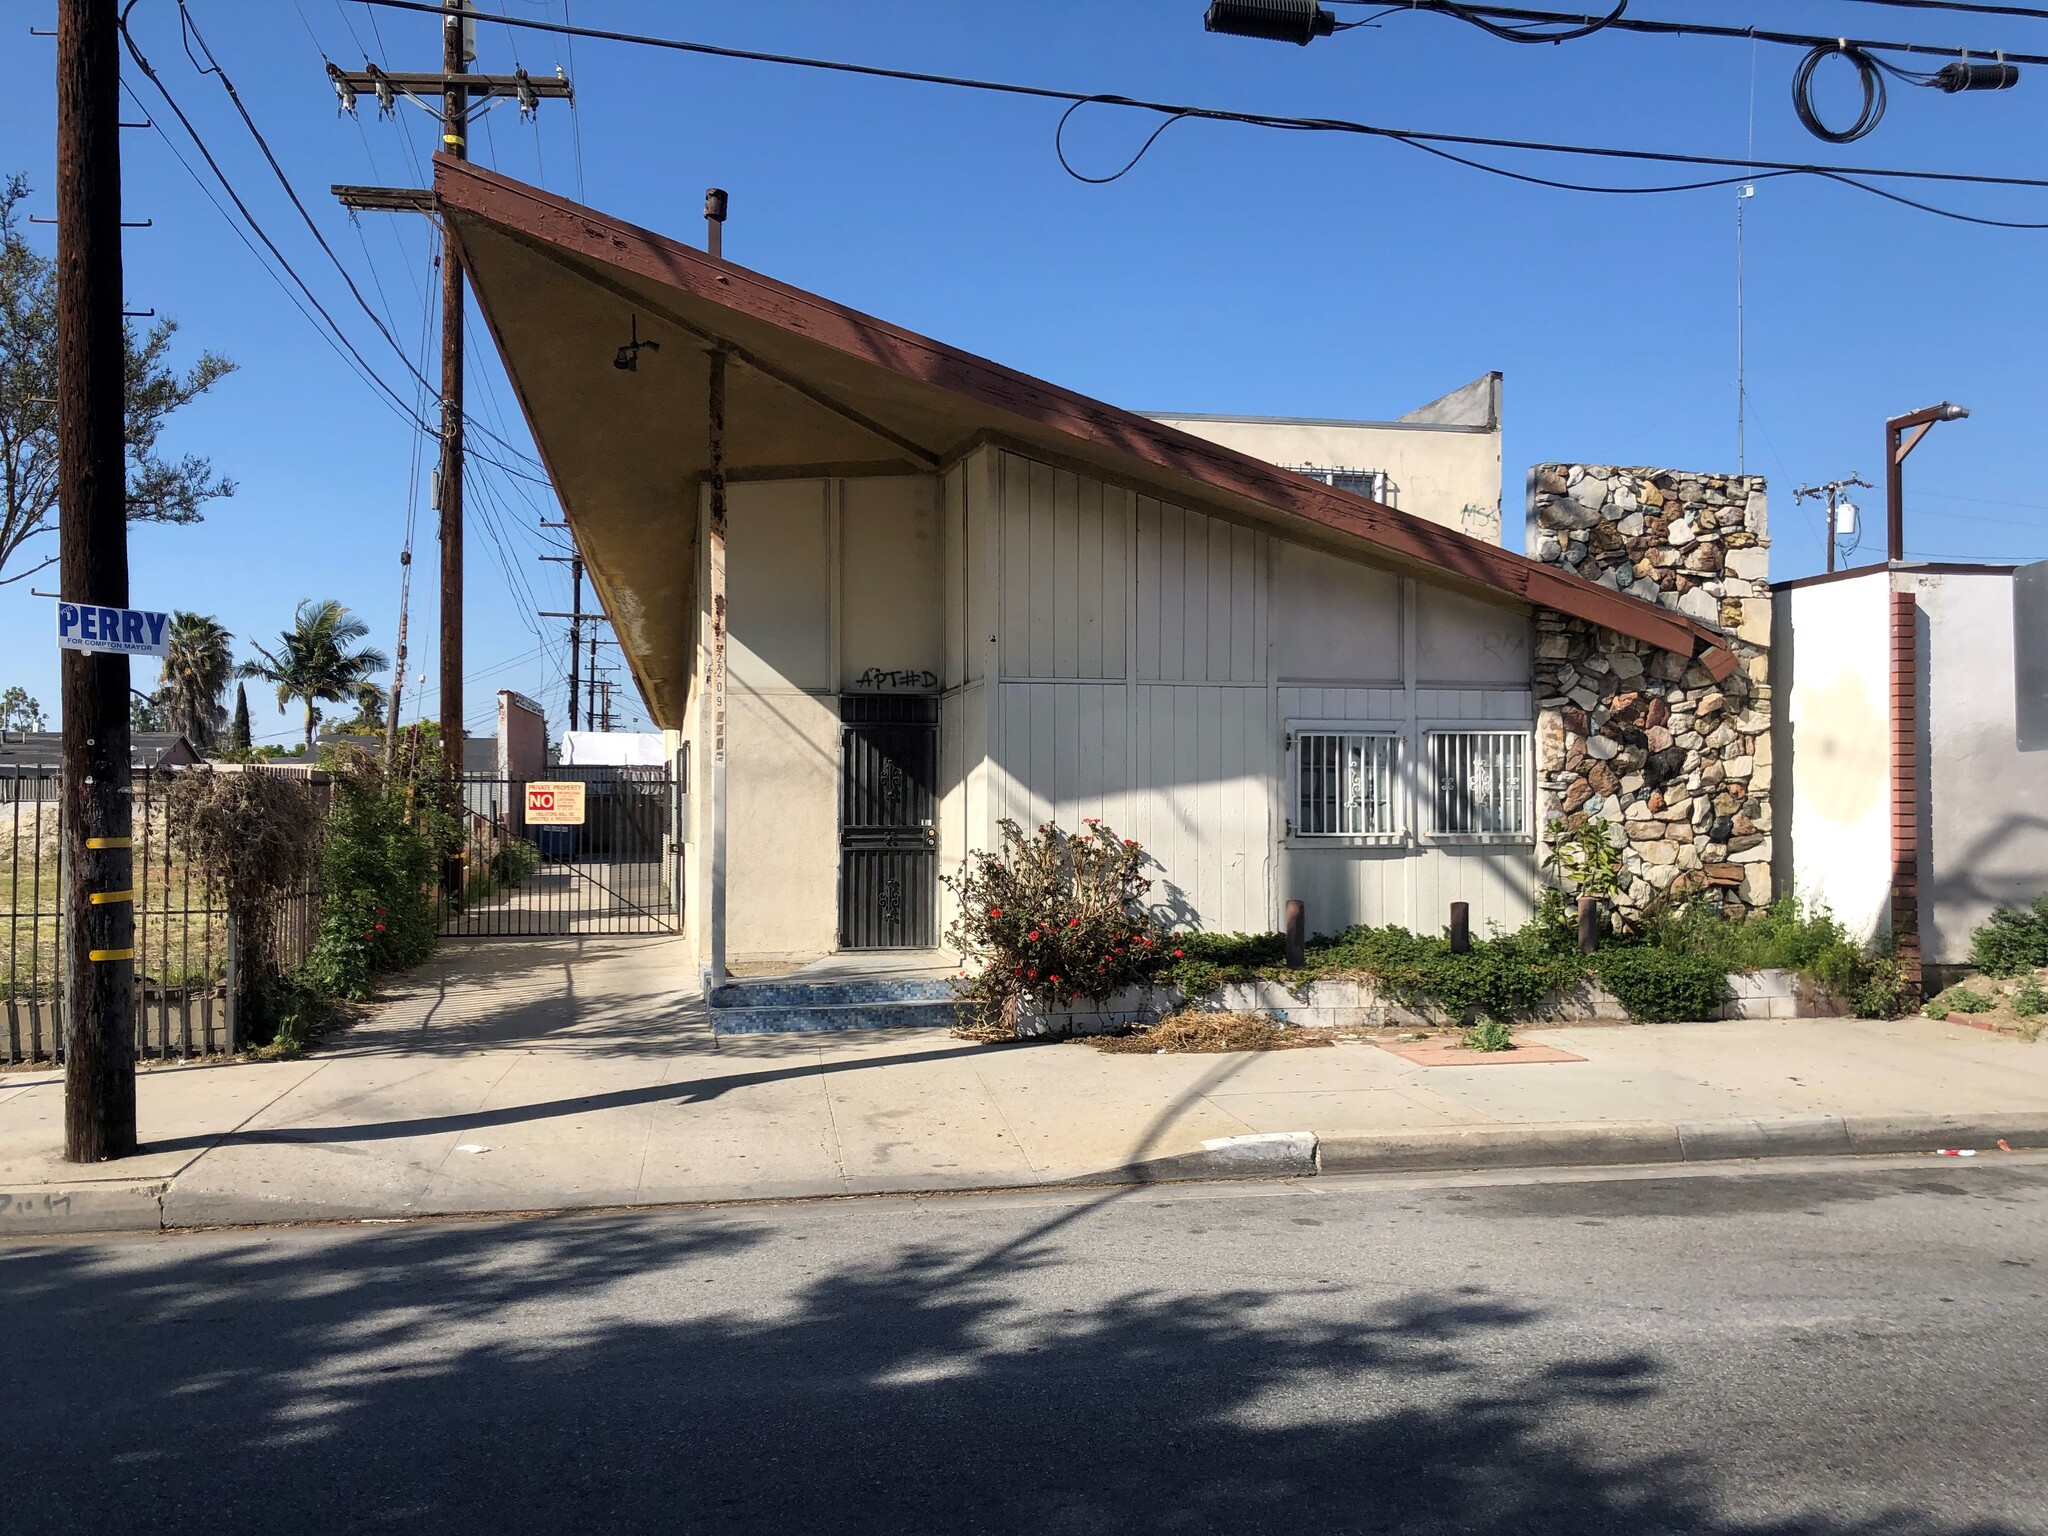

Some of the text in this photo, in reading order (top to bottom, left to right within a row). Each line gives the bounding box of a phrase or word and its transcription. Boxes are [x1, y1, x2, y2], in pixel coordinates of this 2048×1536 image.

[60, 605, 73, 615] VOTE
[59, 603, 166, 645] PERRY
[67, 637, 83, 645] FOR
[85, 640, 122, 649] COMPTON
[124, 643, 152, 651] MAYOR
[529, 794, 554, 808] NO
